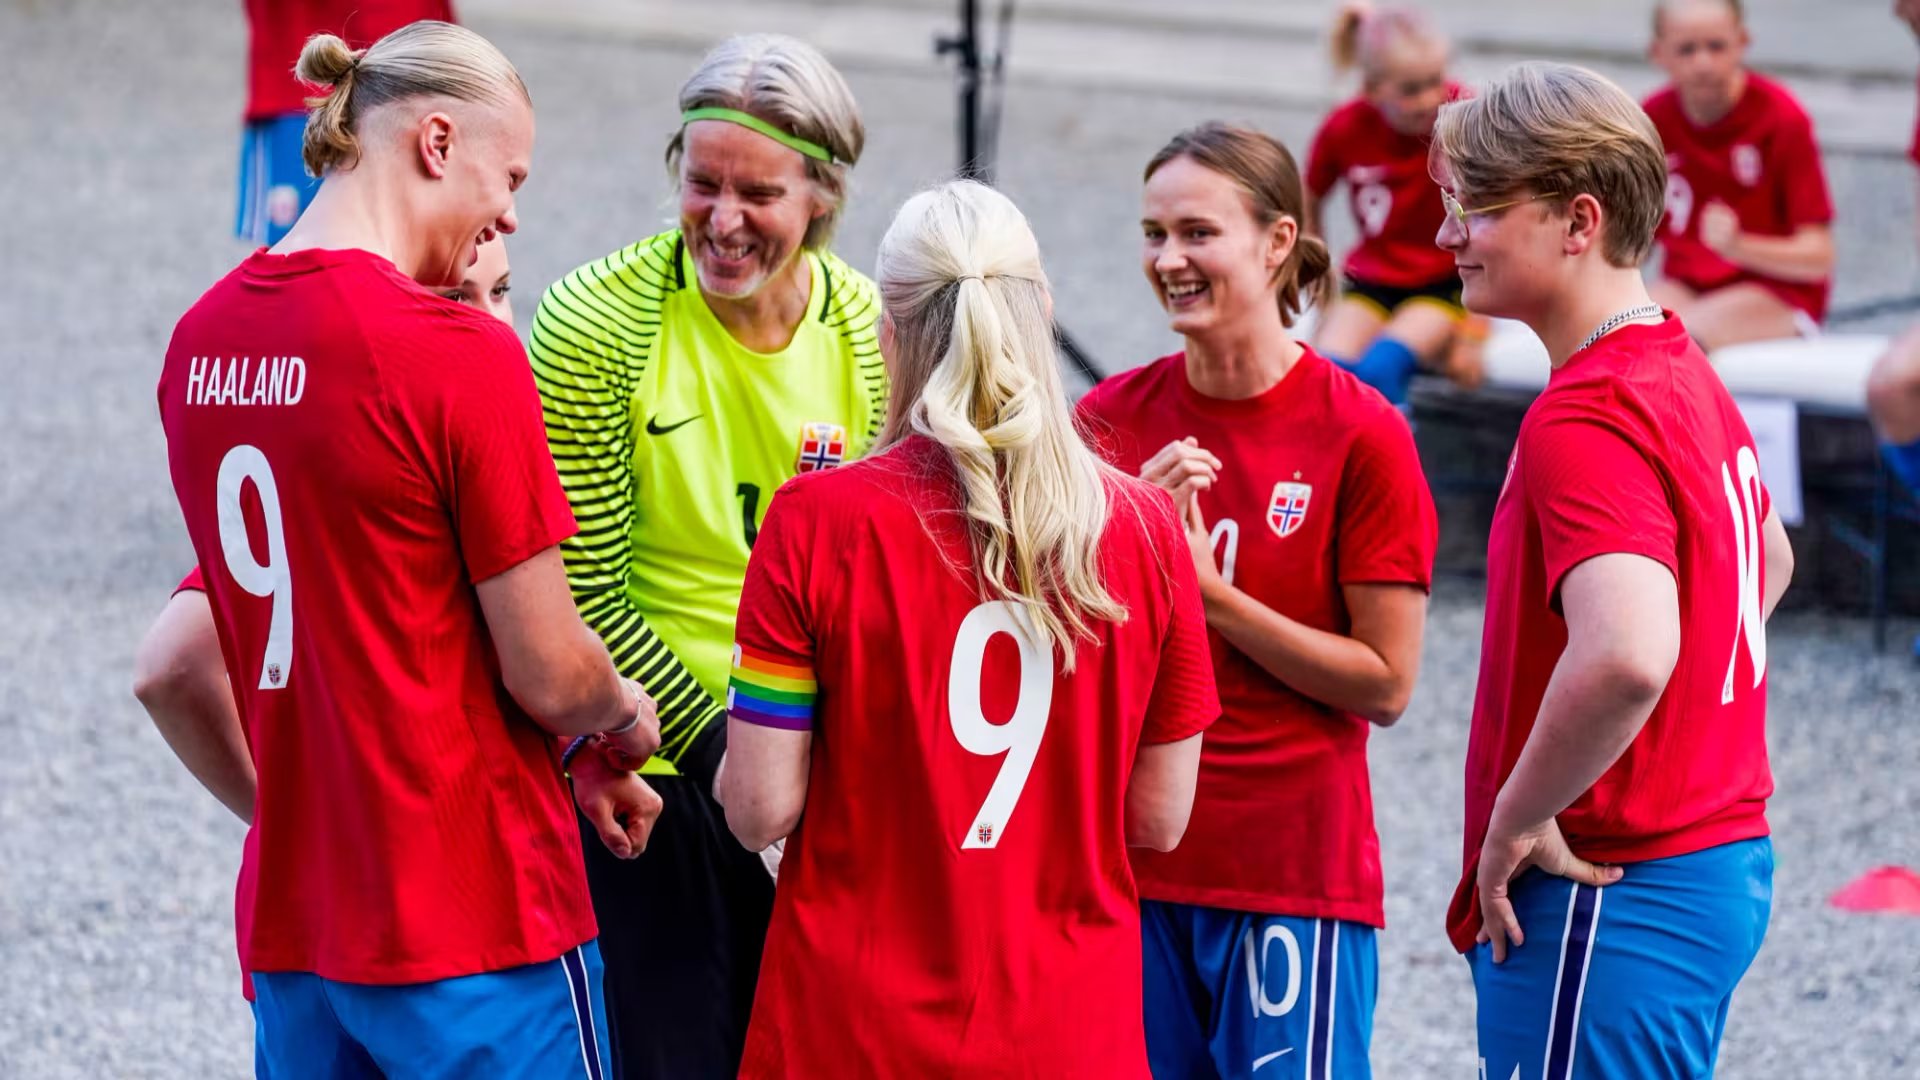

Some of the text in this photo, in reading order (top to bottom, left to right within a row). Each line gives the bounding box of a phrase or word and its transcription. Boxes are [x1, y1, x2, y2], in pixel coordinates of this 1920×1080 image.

[186, 356, 306, 406] HAALAND
[216, 444, 293, 690] 9
[1721, 446, 1767, 705] 10
[948, 599, 1054, 850] 9
[1244, 924, 1302, 1018] 10
